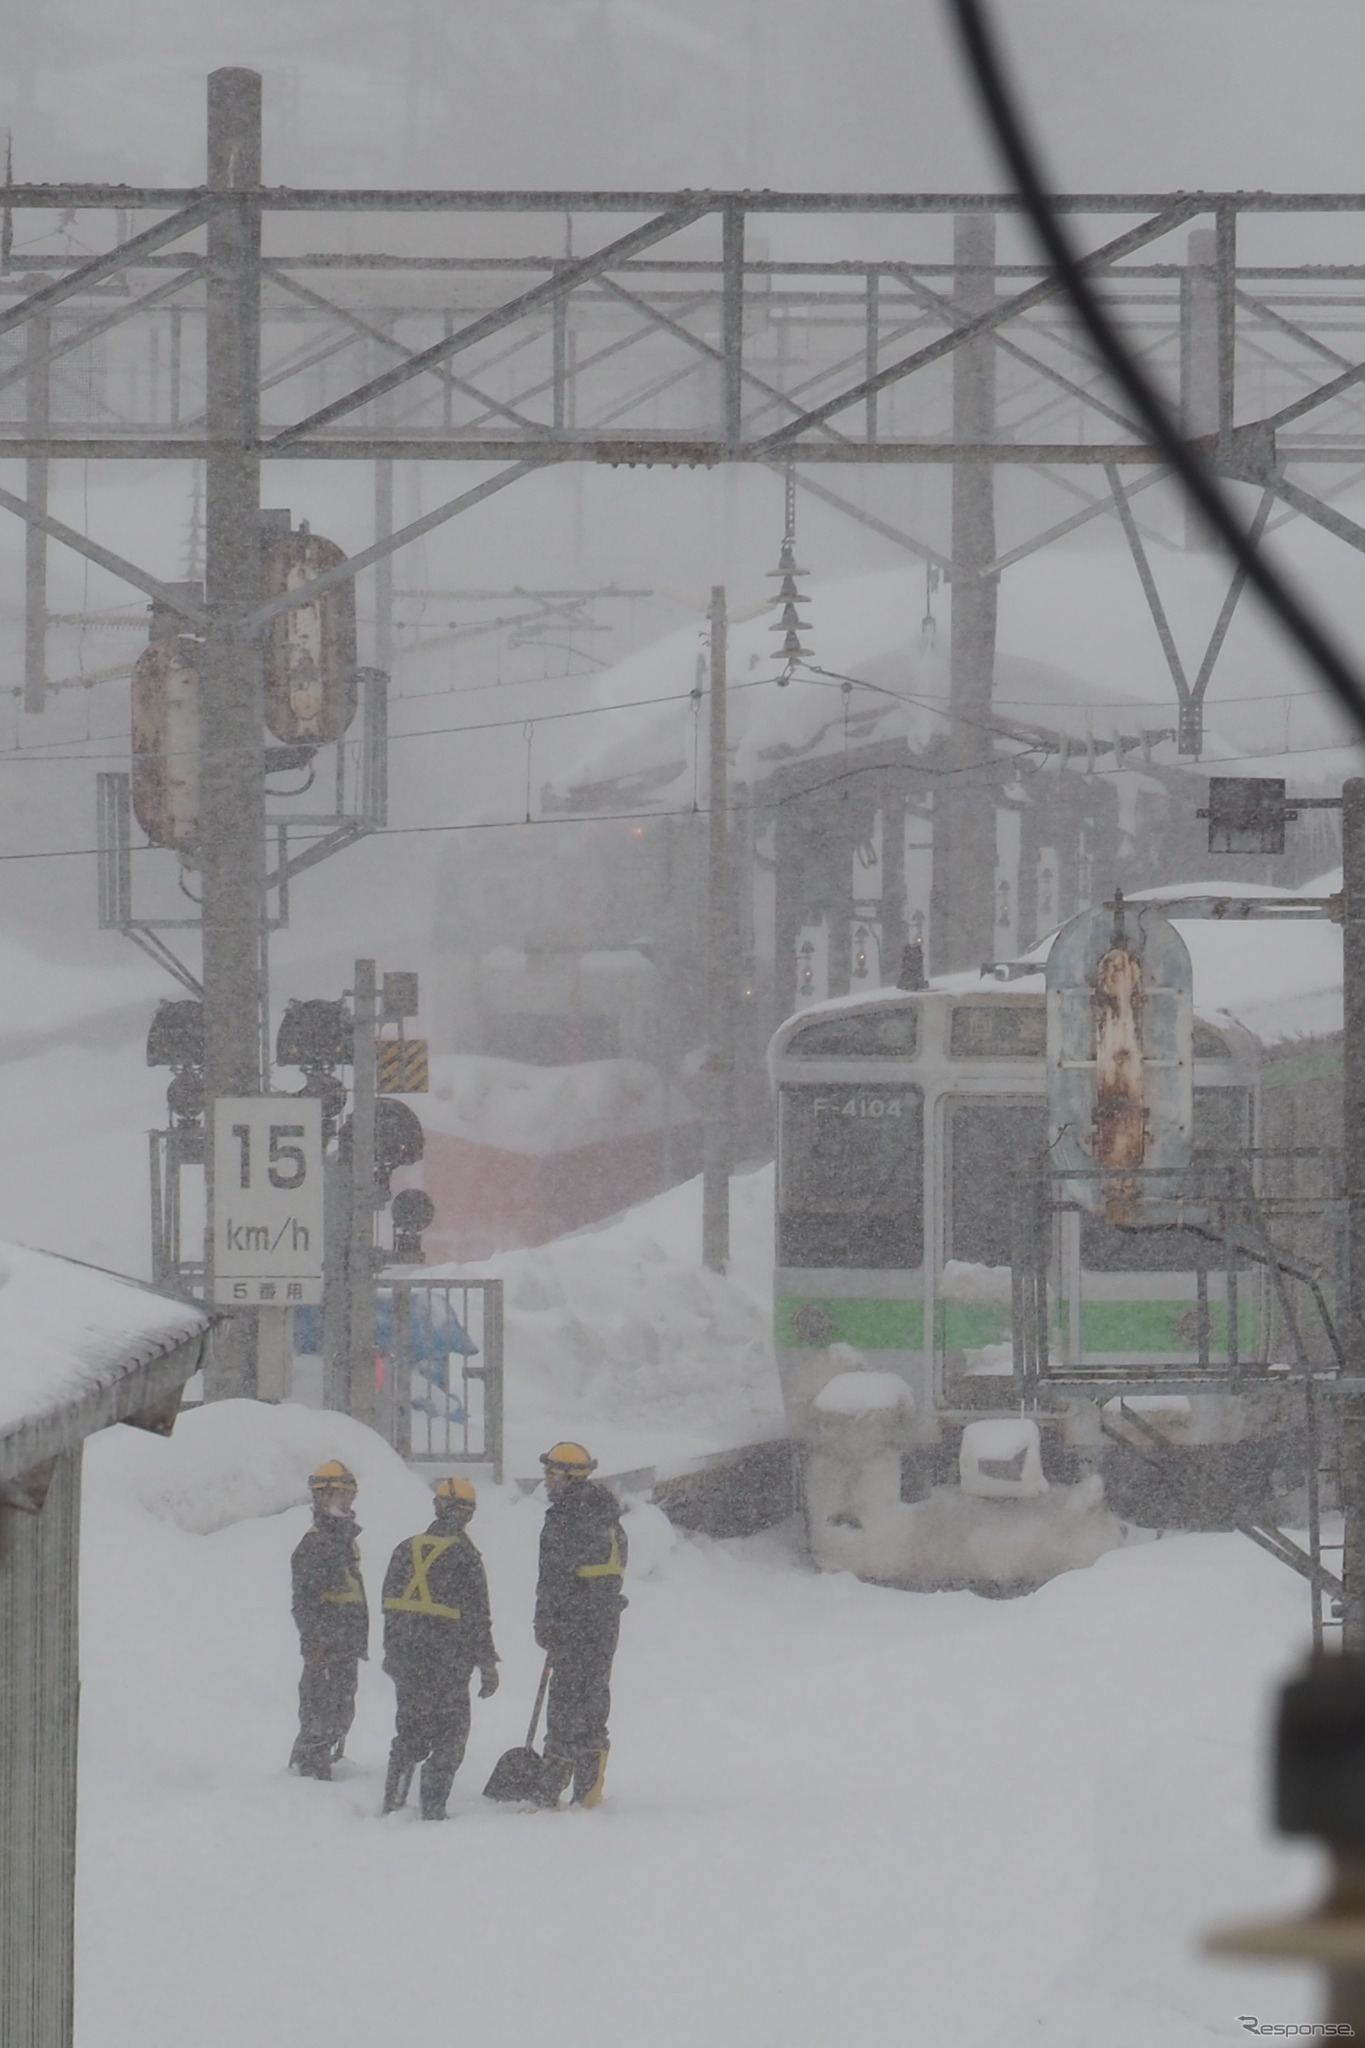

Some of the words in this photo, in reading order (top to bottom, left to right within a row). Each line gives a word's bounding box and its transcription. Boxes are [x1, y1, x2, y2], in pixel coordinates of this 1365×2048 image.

[814, 1099, 902, 1117] F-4104
[232, 1125, 307, 1189] 15
[227, 1217, 310, 1254] km/h
